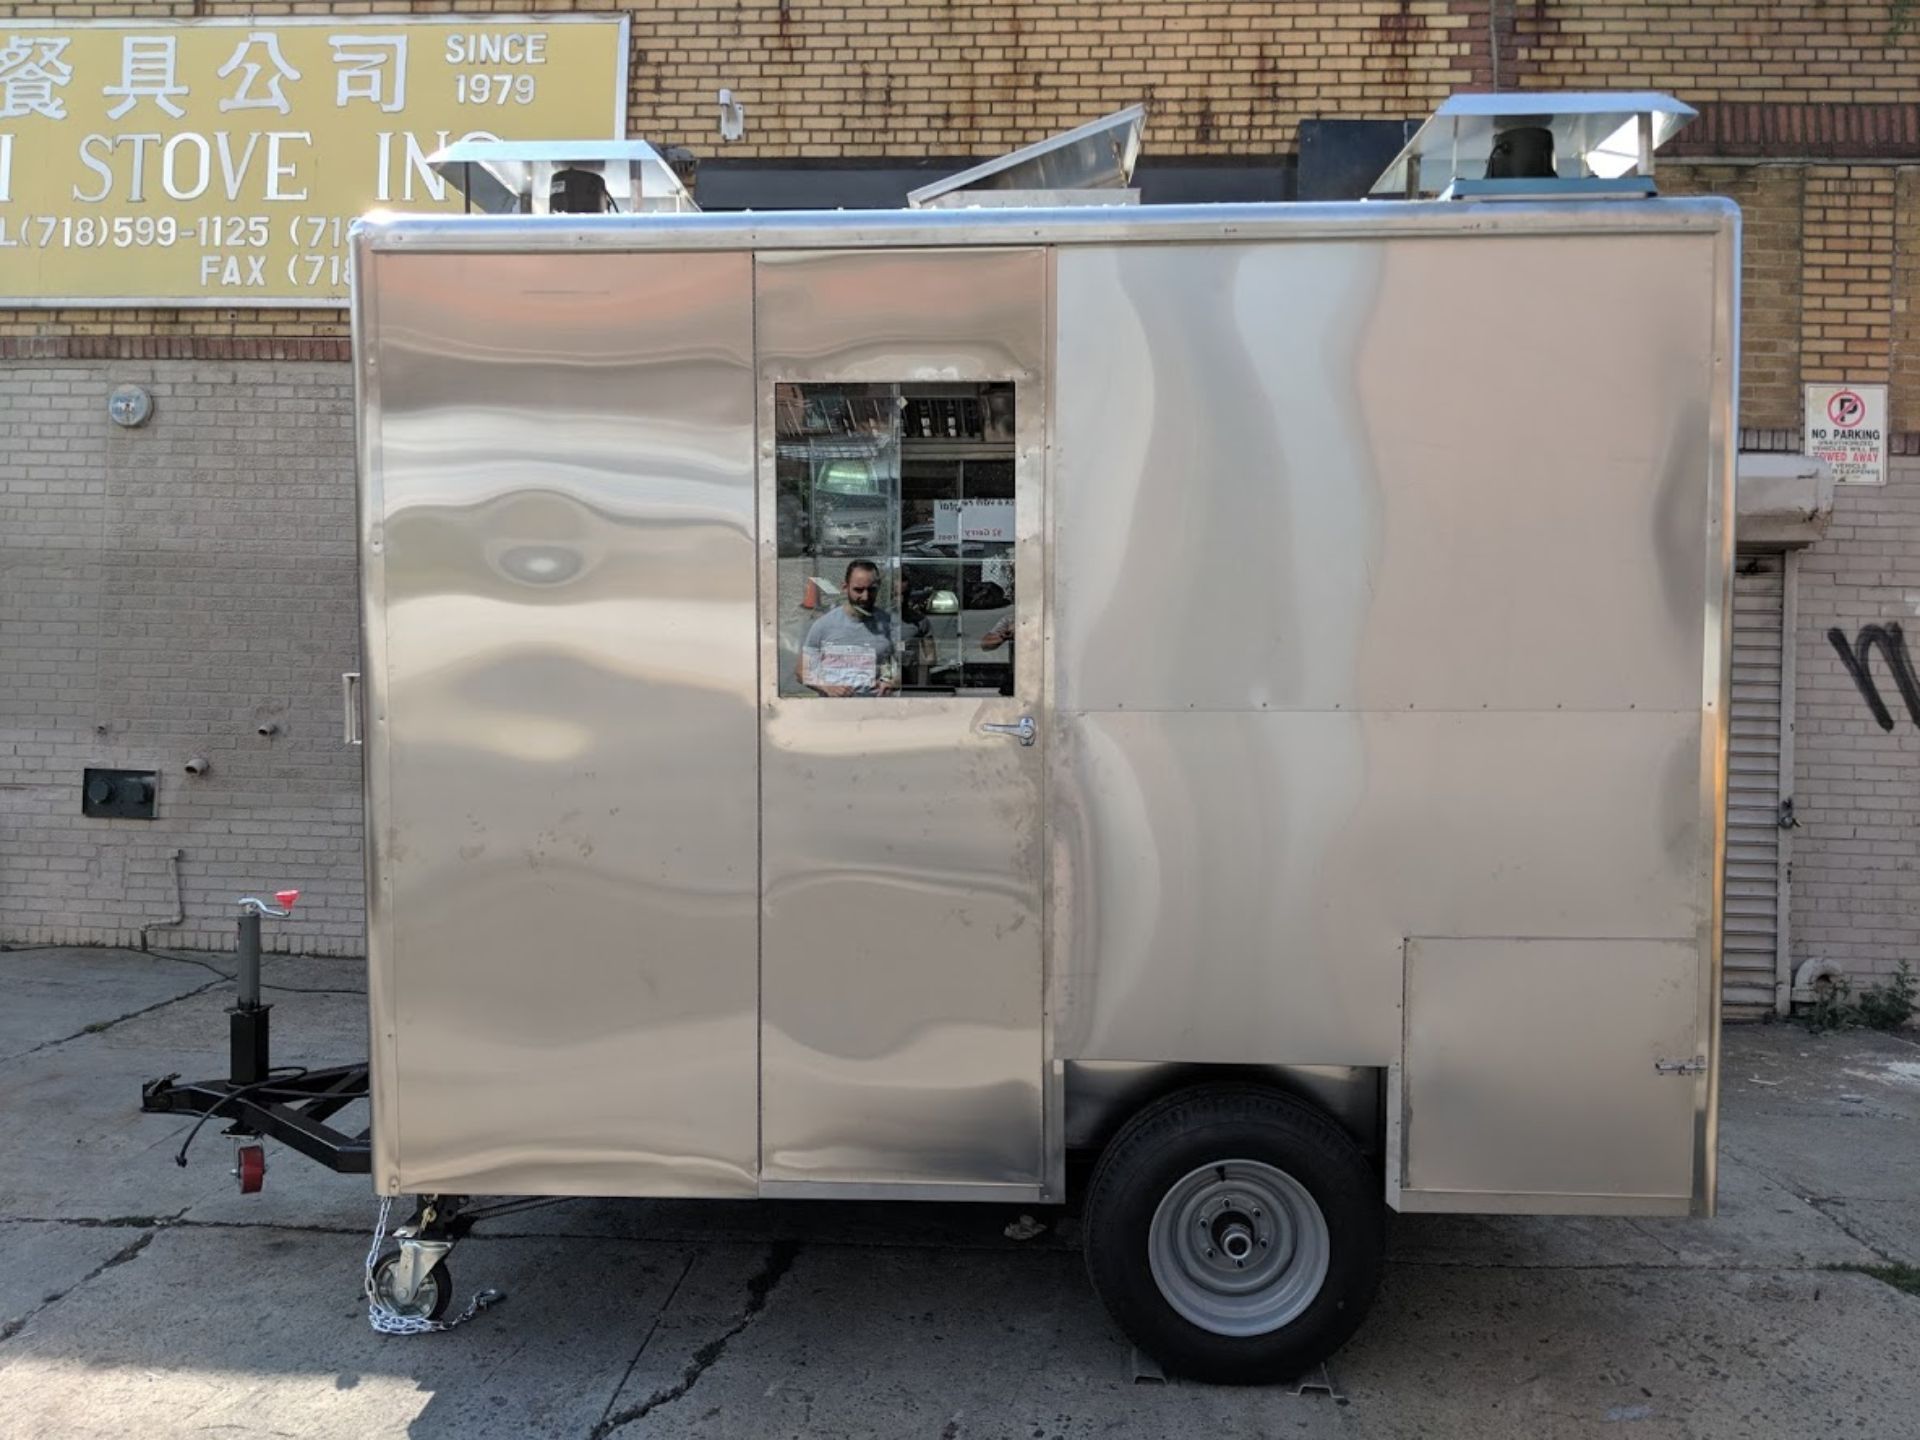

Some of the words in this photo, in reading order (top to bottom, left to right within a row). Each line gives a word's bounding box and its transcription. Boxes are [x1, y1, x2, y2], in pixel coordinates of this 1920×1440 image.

[445, 33, 547, 64] SINCE
[0, 32, 408, 120] 餐具公司
[455, 73, 535, 105] 1979
[73, 131, 312, 202] STOVE
[374, 131, 504, 202] IN
[200, 255, 267, 287] FAX
[1811, 429, 1827, 439] NO
[1833, 429, 1880, 440] PARKING
[1853, 452, 1878, 463] AWAY
